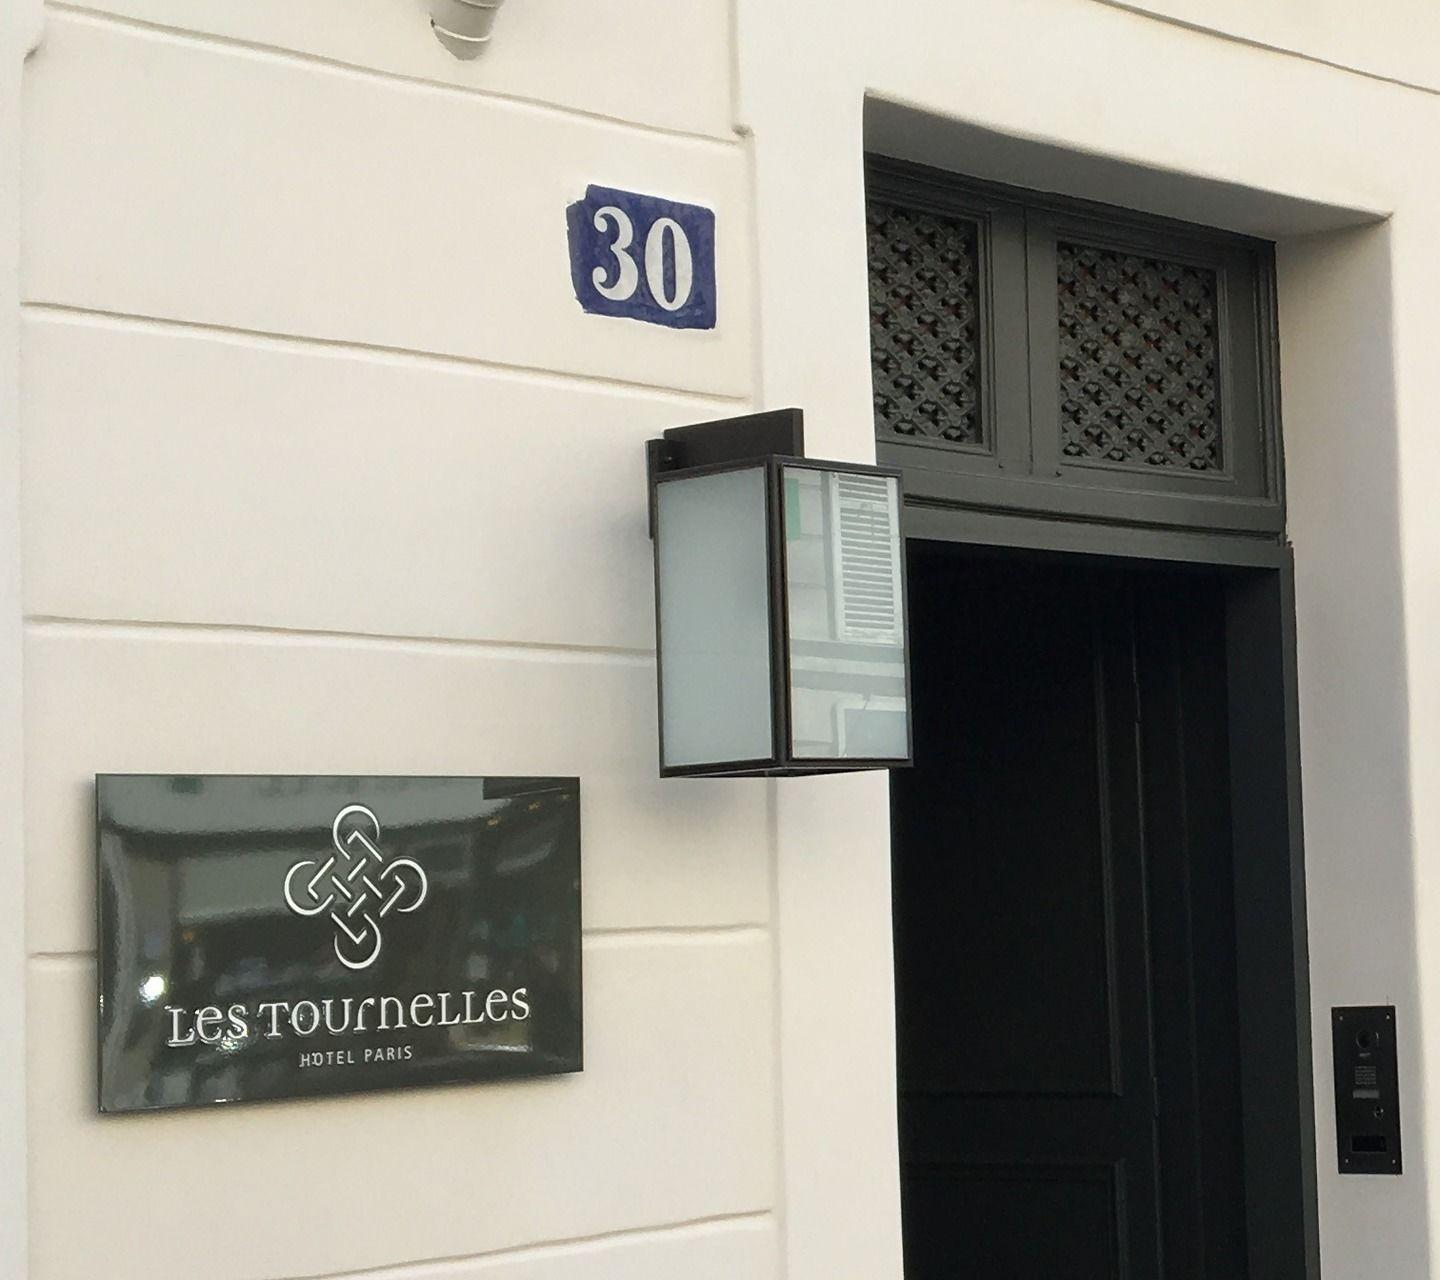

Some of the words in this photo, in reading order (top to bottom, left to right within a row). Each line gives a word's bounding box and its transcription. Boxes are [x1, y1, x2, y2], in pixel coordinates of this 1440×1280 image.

[592, 206, 693, 312] 30
[300, 1049, 355, 1068] HOTEL
[364, 1045, 414, 1063] PARIS
